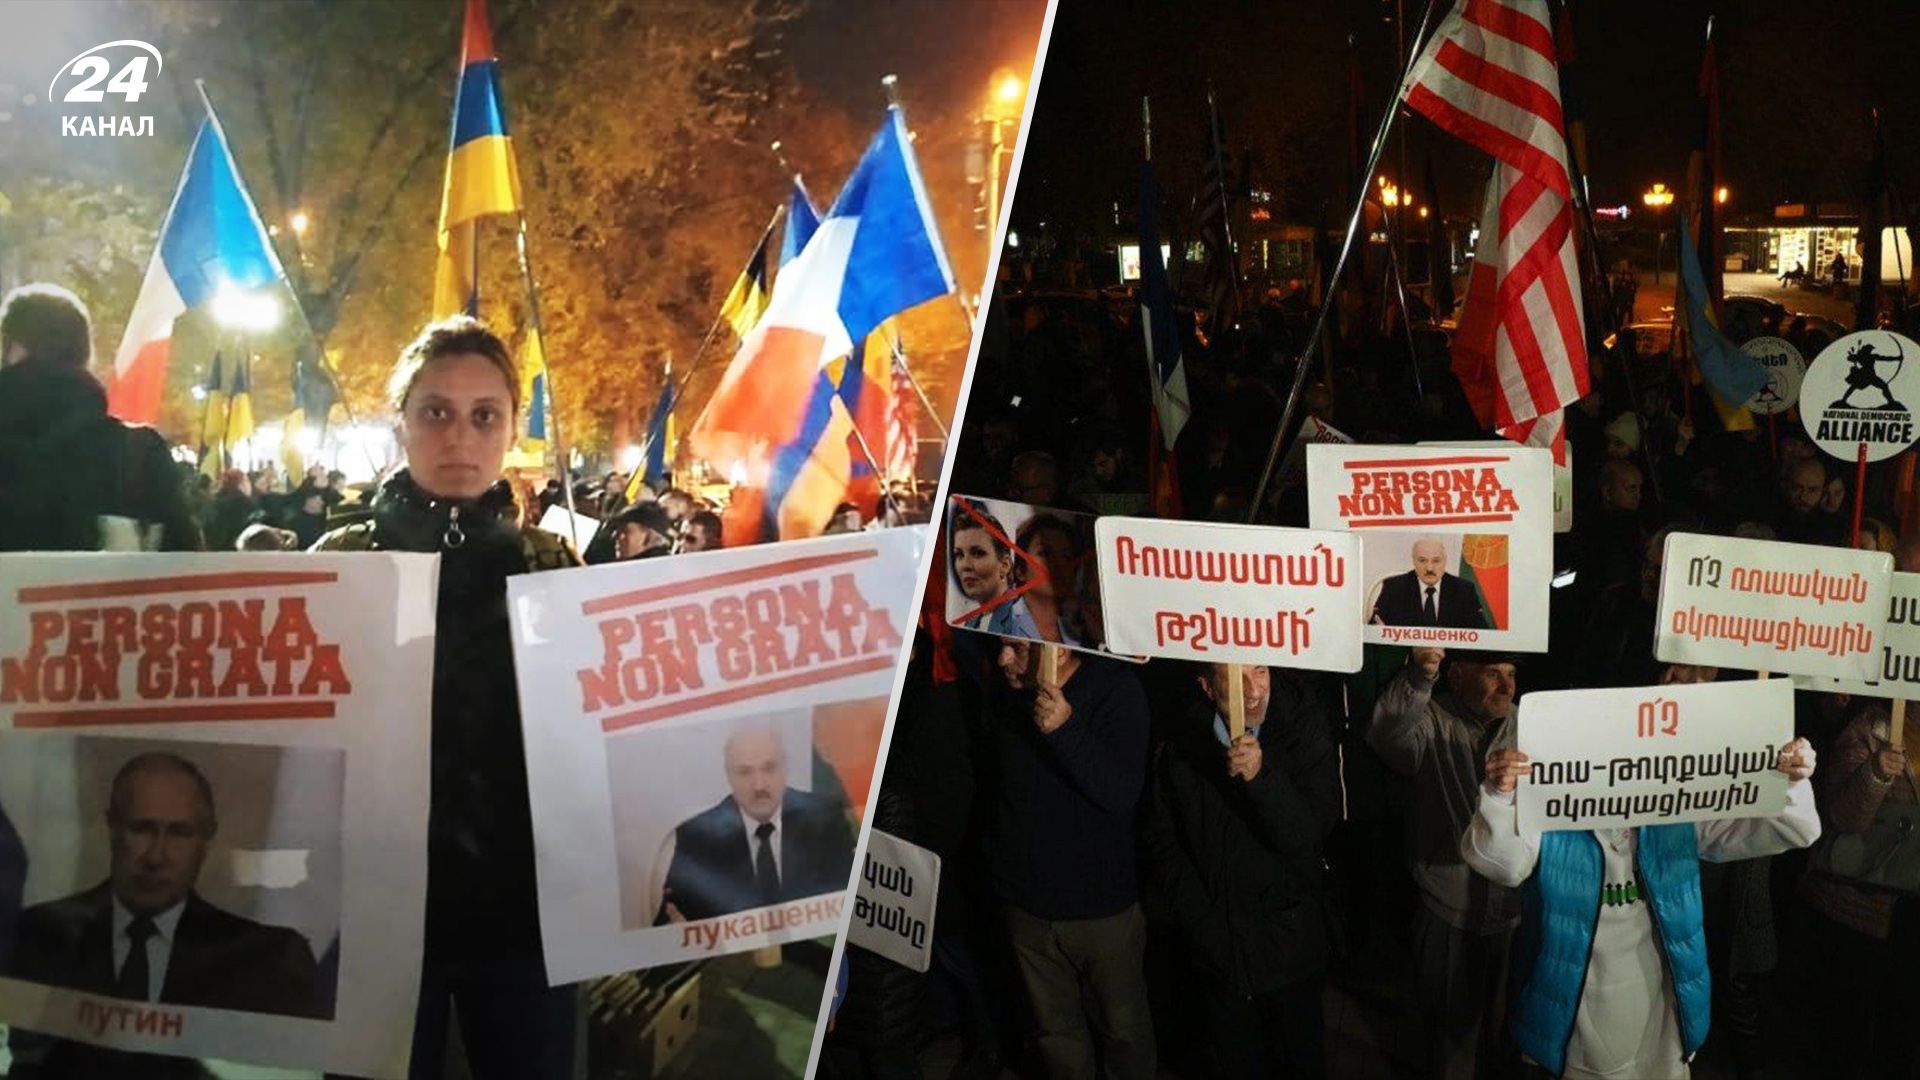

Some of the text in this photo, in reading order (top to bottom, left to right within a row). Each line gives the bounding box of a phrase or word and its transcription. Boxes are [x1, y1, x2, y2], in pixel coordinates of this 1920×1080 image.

[1816, 420, 1913, 443] ALLIANCE
[1823, 410, 1911, 421] NATIONAL DEMOCRATIC
[1351, 468, 1502, 494] PERSONA
[1338, 490, 1520, 517] NON GRATA
[1730, 567, 1867, 605] ռուսական
[29, 596, 318, 657] PERSONA
[598, 573, 871, 665] PERSONA
[1381, 628, 1479, 642] лукашенко
[1672, 606, 1872, 656] օկուպացիային
[0, 644, 352, 703] NON GRATA
[577, 607, 903, 714] NON GRATA
[1546, 781, 1759, 822] օկուպացիային
[681, 895, 845, 950] лукашенк
[78, 1000, 183, 1038] путин
